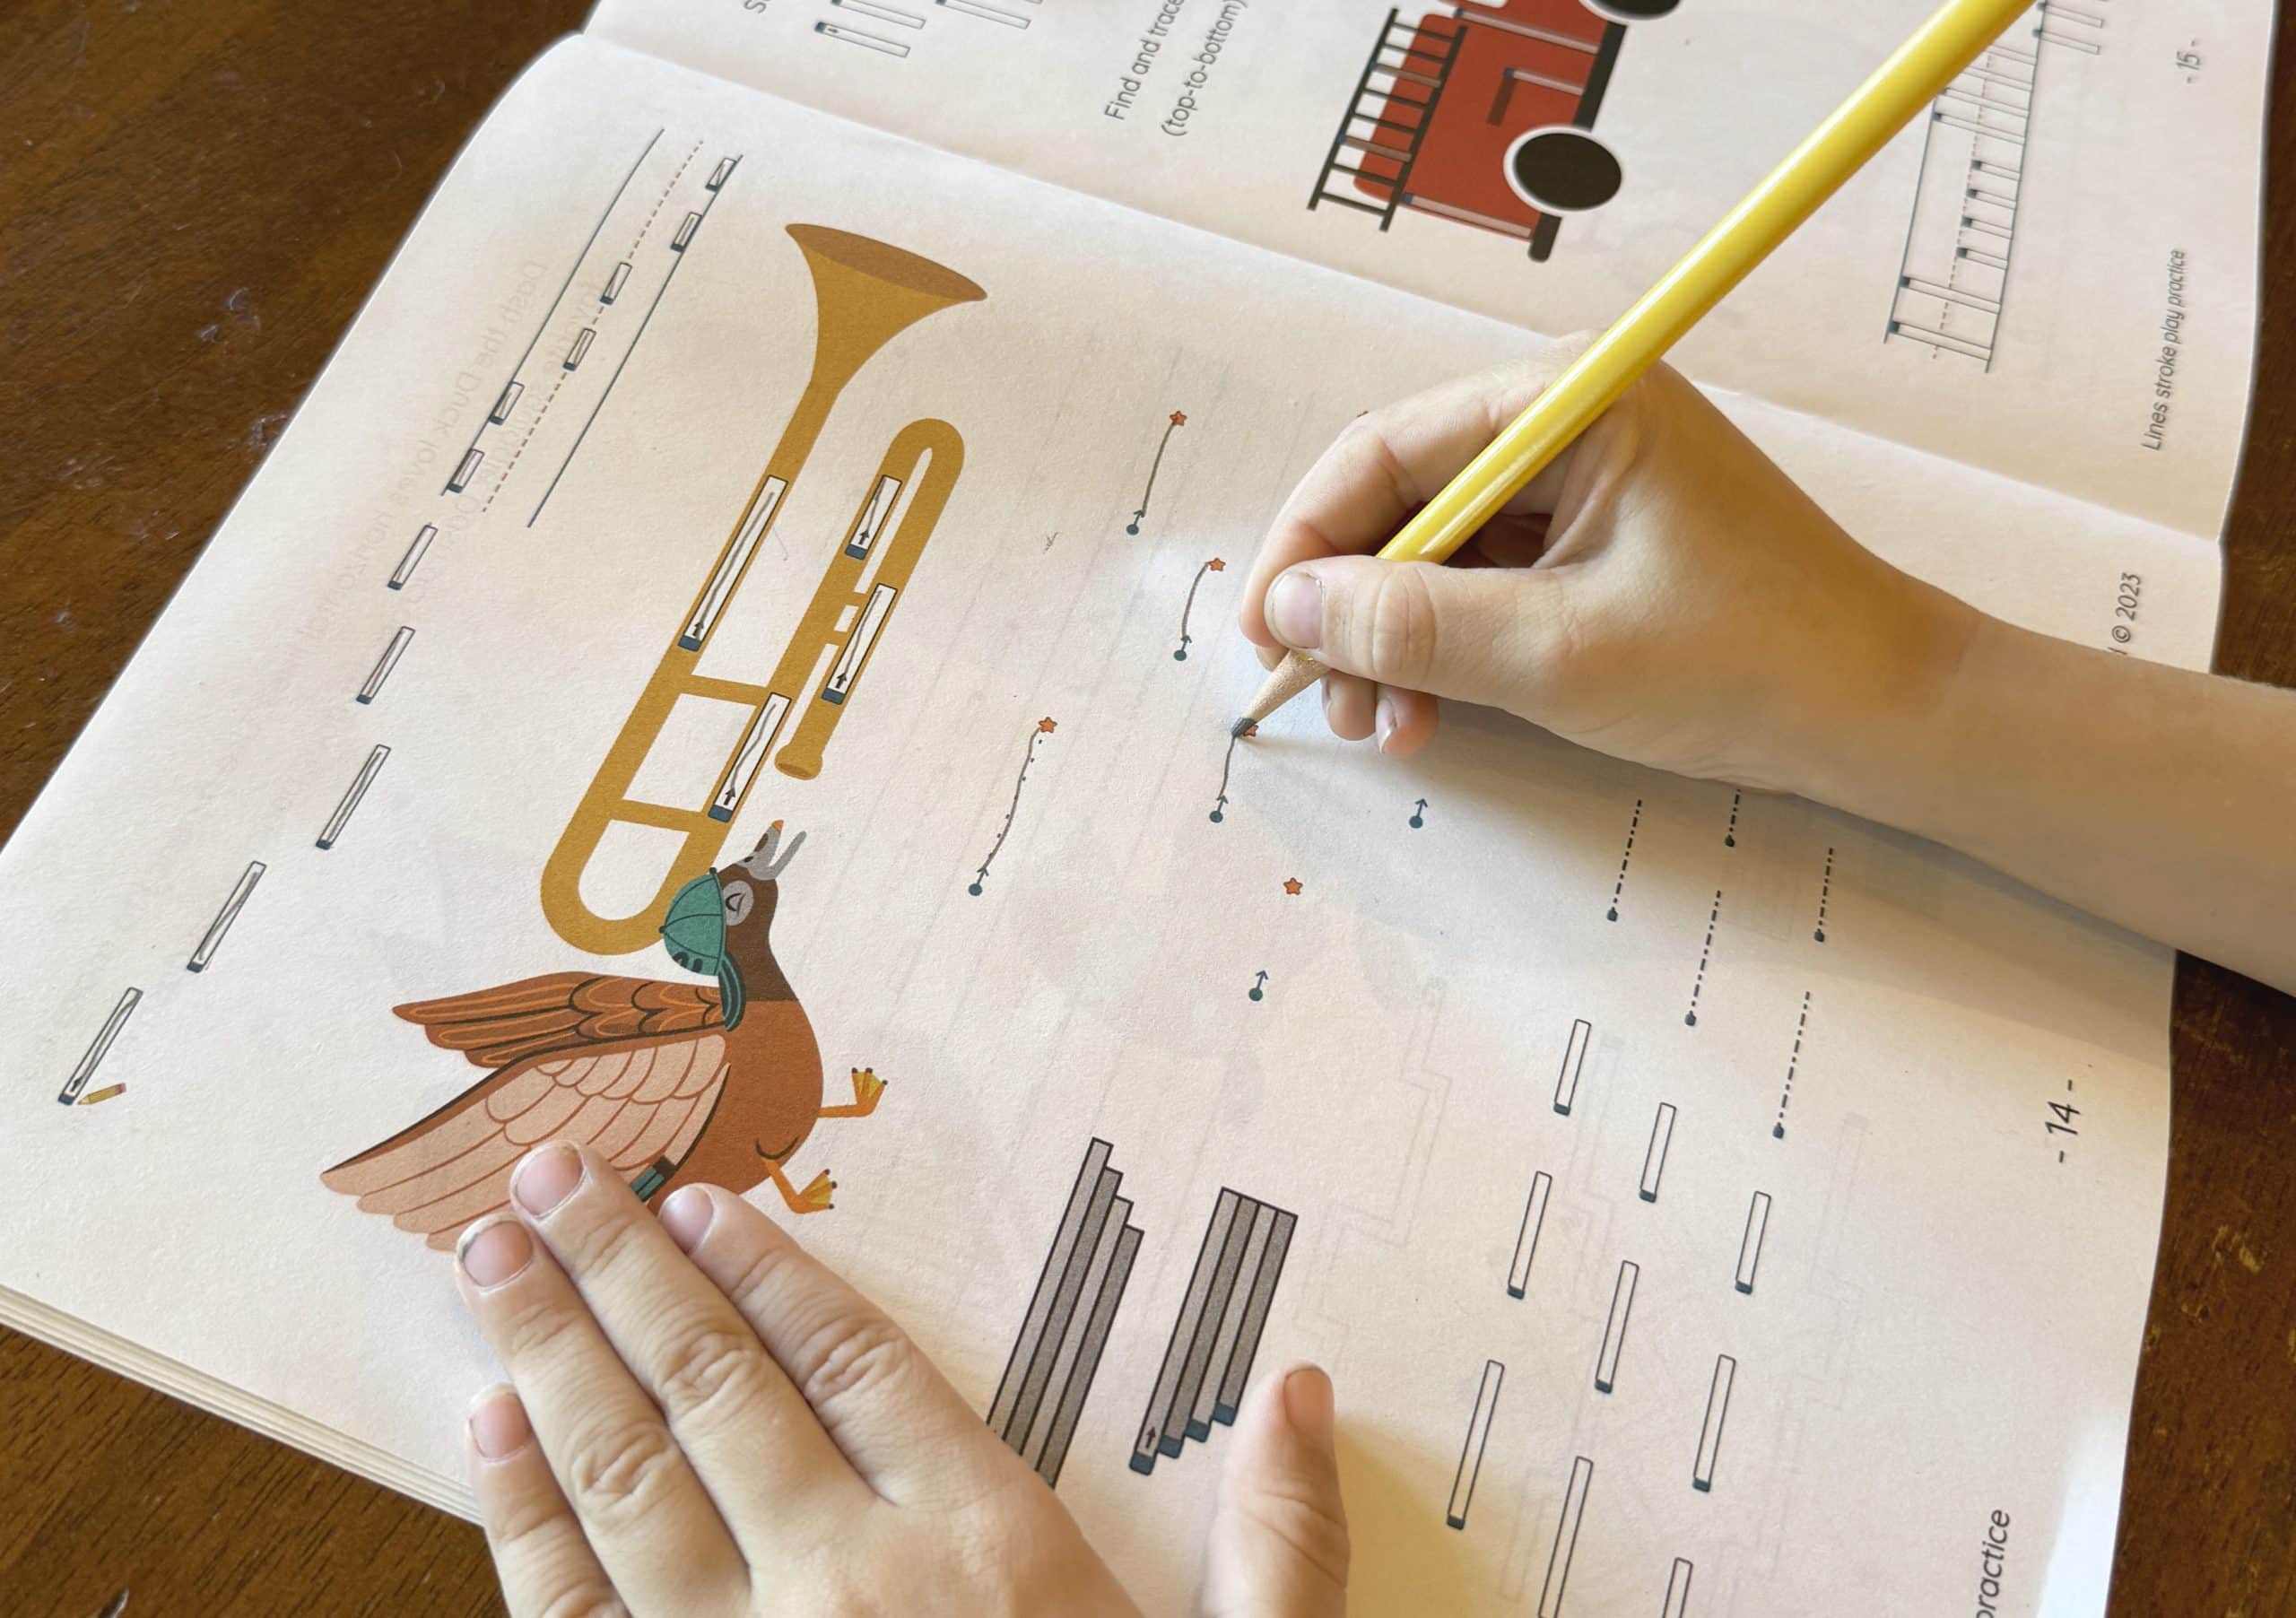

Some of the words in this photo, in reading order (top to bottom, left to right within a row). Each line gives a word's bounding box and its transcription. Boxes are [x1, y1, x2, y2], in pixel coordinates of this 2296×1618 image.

[1104, 77, 1142, 120] Find
[1132, 39, 1161, 75] and
[2175, 50, 2200, 71] 15
[2167, 249, 2186, 309] practice
[2160, 309, 2186, 345] play
[2153, 345, 2177, 399] stroke
[2140, 401, 2168, 451] Lines
[2114, 572, 2142, 622] 2023
[2045, 1100, 2082, 1135] 14
